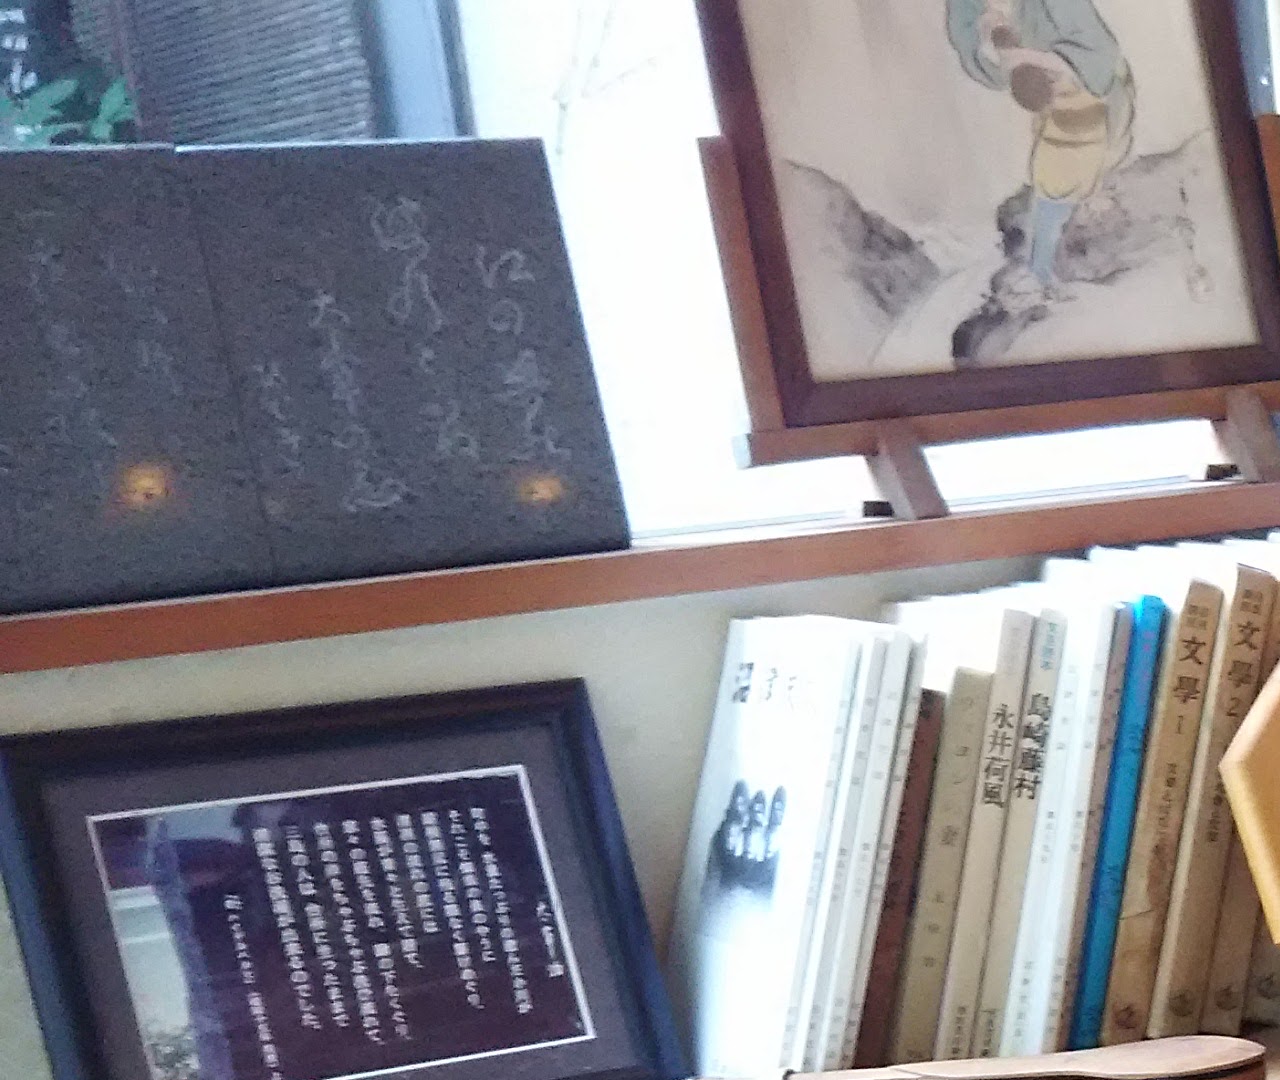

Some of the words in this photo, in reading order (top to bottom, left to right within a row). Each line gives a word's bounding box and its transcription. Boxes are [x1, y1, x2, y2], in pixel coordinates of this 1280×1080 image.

[983, 704, 1014, 808] 永井荷風
[1014, 693, 1051, 799] 島崎藤村
